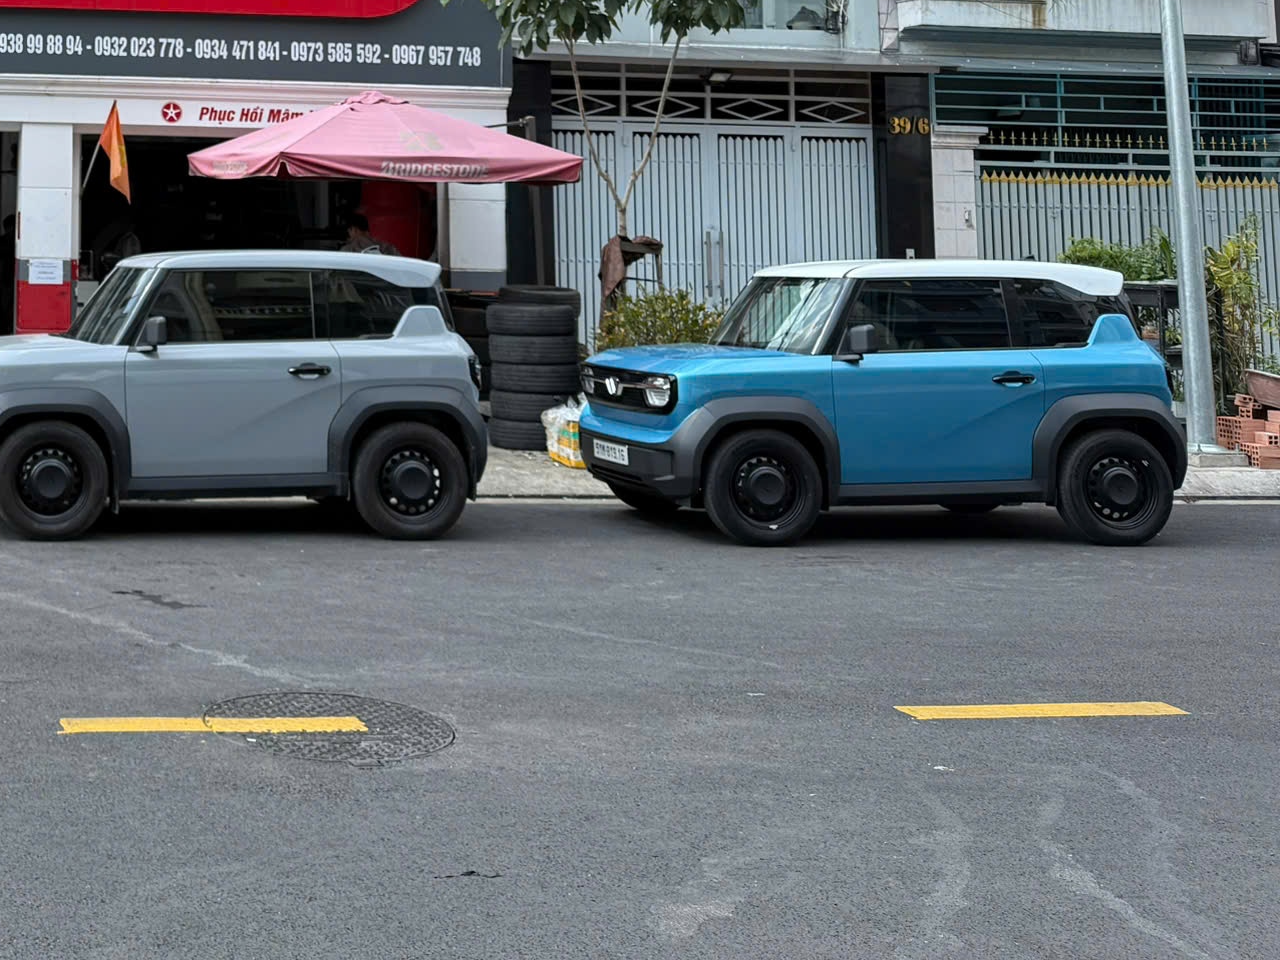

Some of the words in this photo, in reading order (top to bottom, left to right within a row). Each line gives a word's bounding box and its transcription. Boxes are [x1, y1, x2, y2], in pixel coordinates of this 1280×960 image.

[27, 33, 44, 55] 99
[47, 34, 63, 55] 88
[66, 35, 83, 56] 94
[95, 36, 128, 57] 0932
[130, 36, 156, 58] 023
[159, 38, 184, 59] 778
[195, 38, 228, 60] 0934
[232, 40, 255, 61] 471
[258, 40, 280, 61] 841
[291, 41, 324, 63] 0973
[328, 42, 353, 63] 585
[357, 43, 382, 64] 592
[392, 44, 425, 65] 0967
[429, 45, 454, 66] 957
[457, 46, 482, 67] 748
[199, 107, 235, 125] Phục
[890, 115, 930, 135] 39/6
